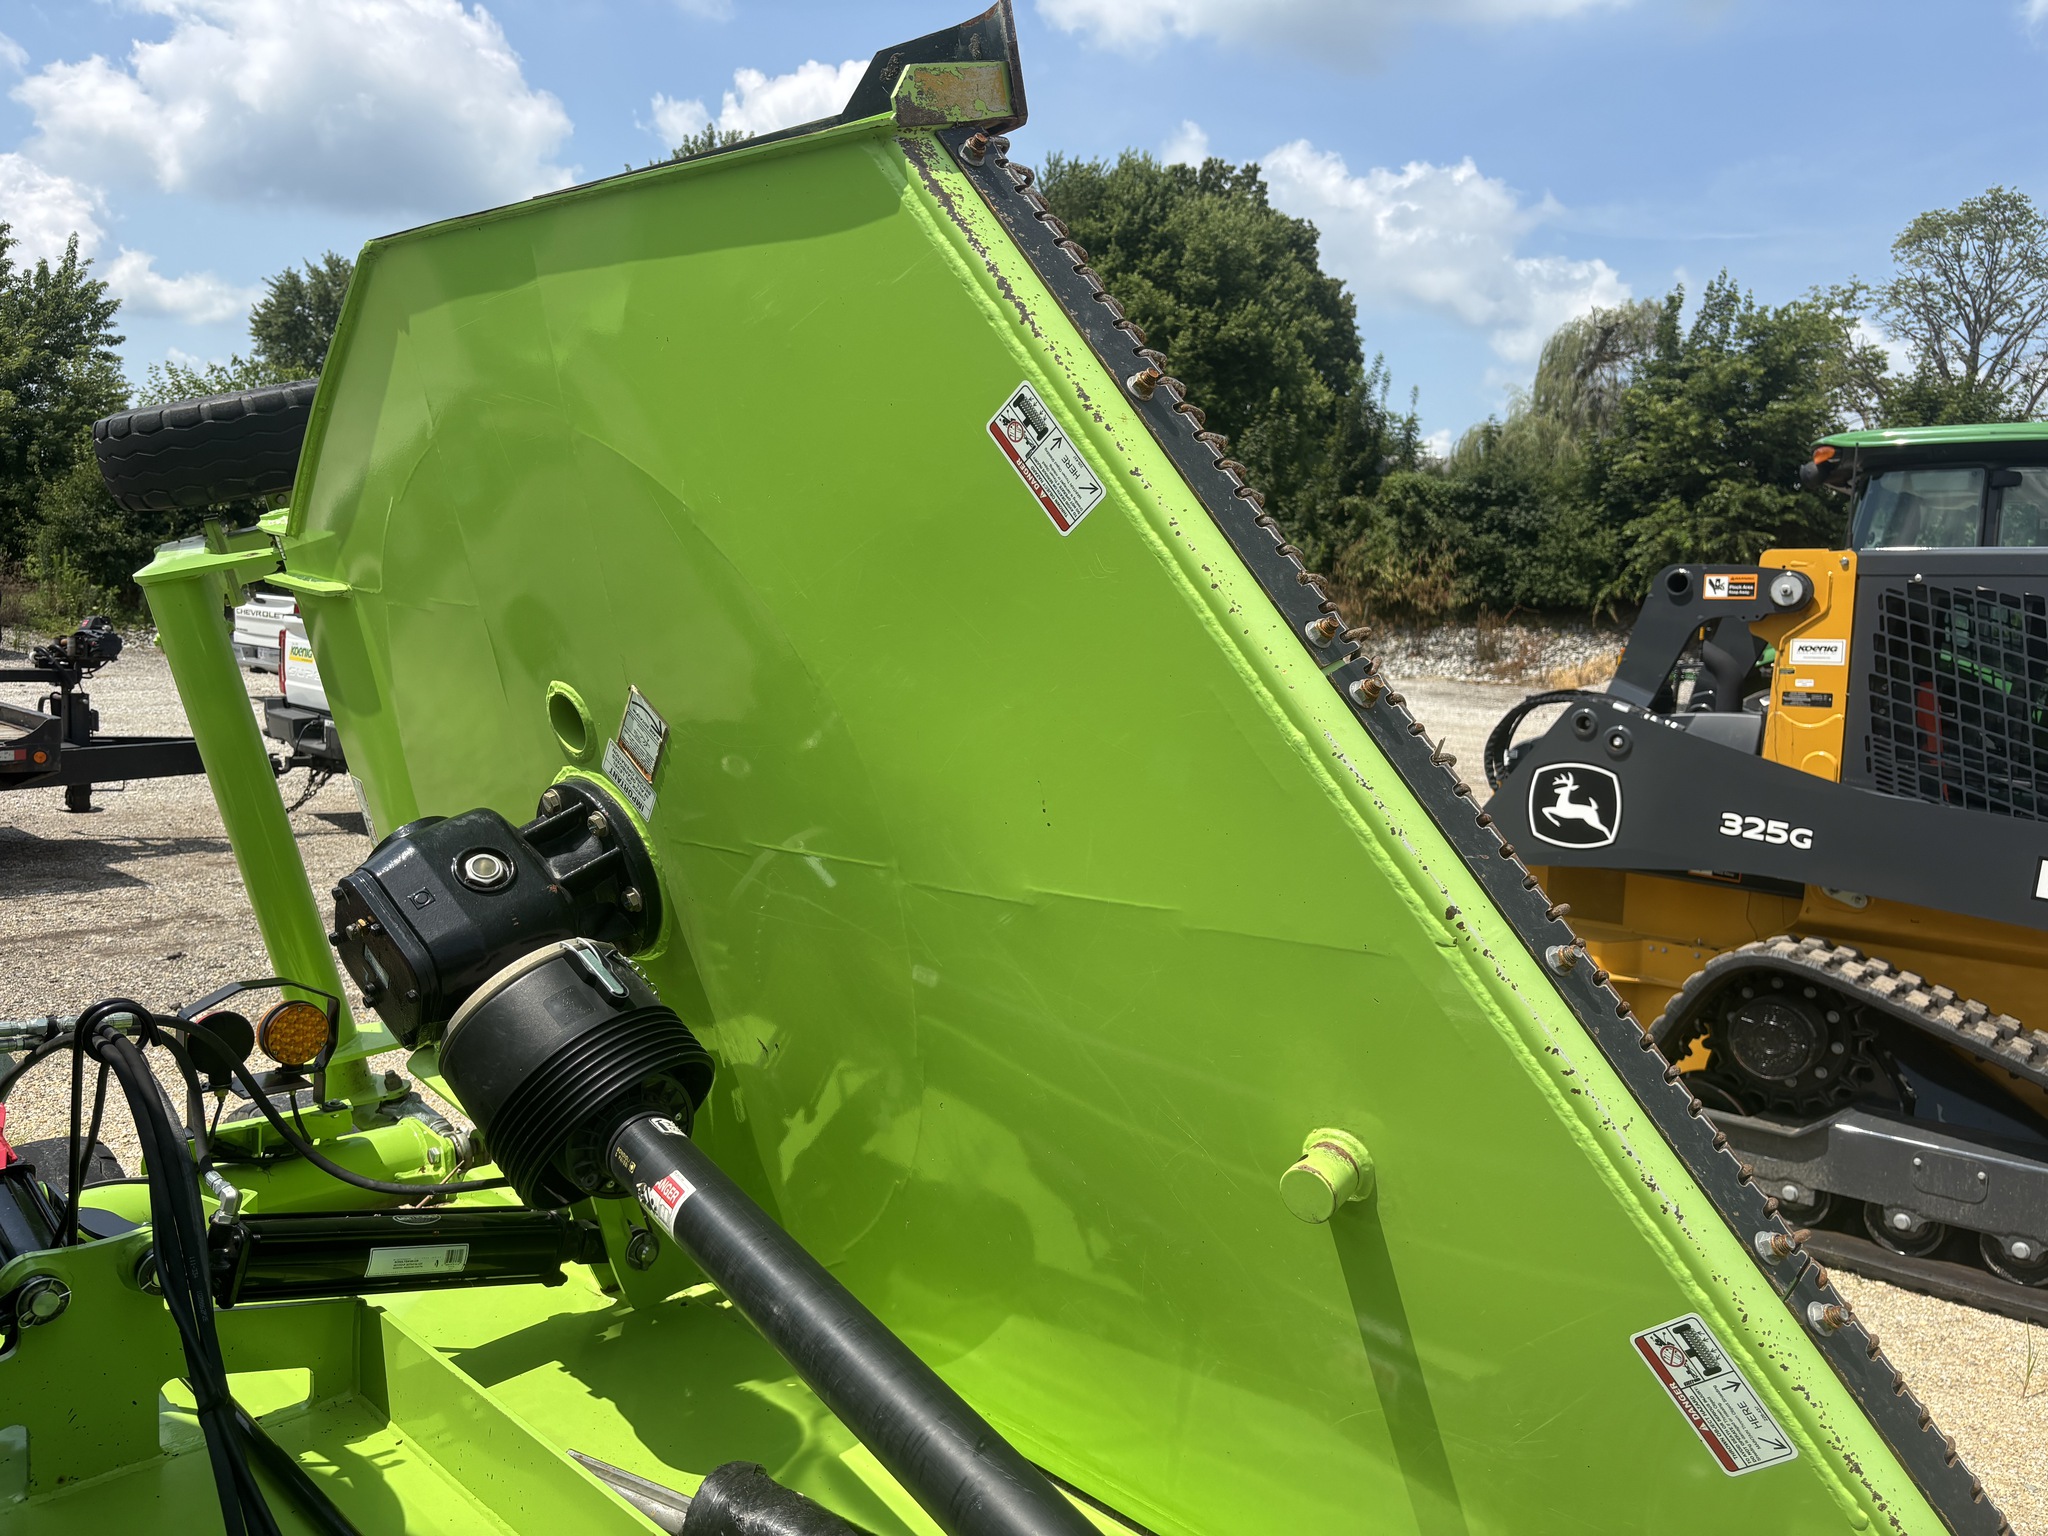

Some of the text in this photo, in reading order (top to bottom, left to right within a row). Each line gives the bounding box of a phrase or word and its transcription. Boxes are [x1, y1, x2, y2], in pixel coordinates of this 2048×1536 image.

[1016, 457, 1040, 490] DANGER
[1060, 454, 1080, 480] HERE
[1030, 465, 1068, 517] THROWN OBJECT HAZARD
[609, 766, 644, 812] IMPORTANT
[1720, 811, 1814, 850] 325G
[1668, 1381, 1700, 1420] DANGER
[1711, 1384, 1727, 1402] Shielding
[1724, 1402, 1736, 1415] Object
[1736, 1400, 1762, 1429] HERE
[1689, 1395, 1737, 1459] THROWN OBJECT HAZARD
[1724, 1429, 1737, 1444] DEATH
[1728, 1426, 1745, 1446] OPERATE
[1744, 1429, 1761, 1449] MAINTAIN
[1734, 1443, 1747, 1457] AVOID
[1742, 1446, 1752, 1455] NOT
